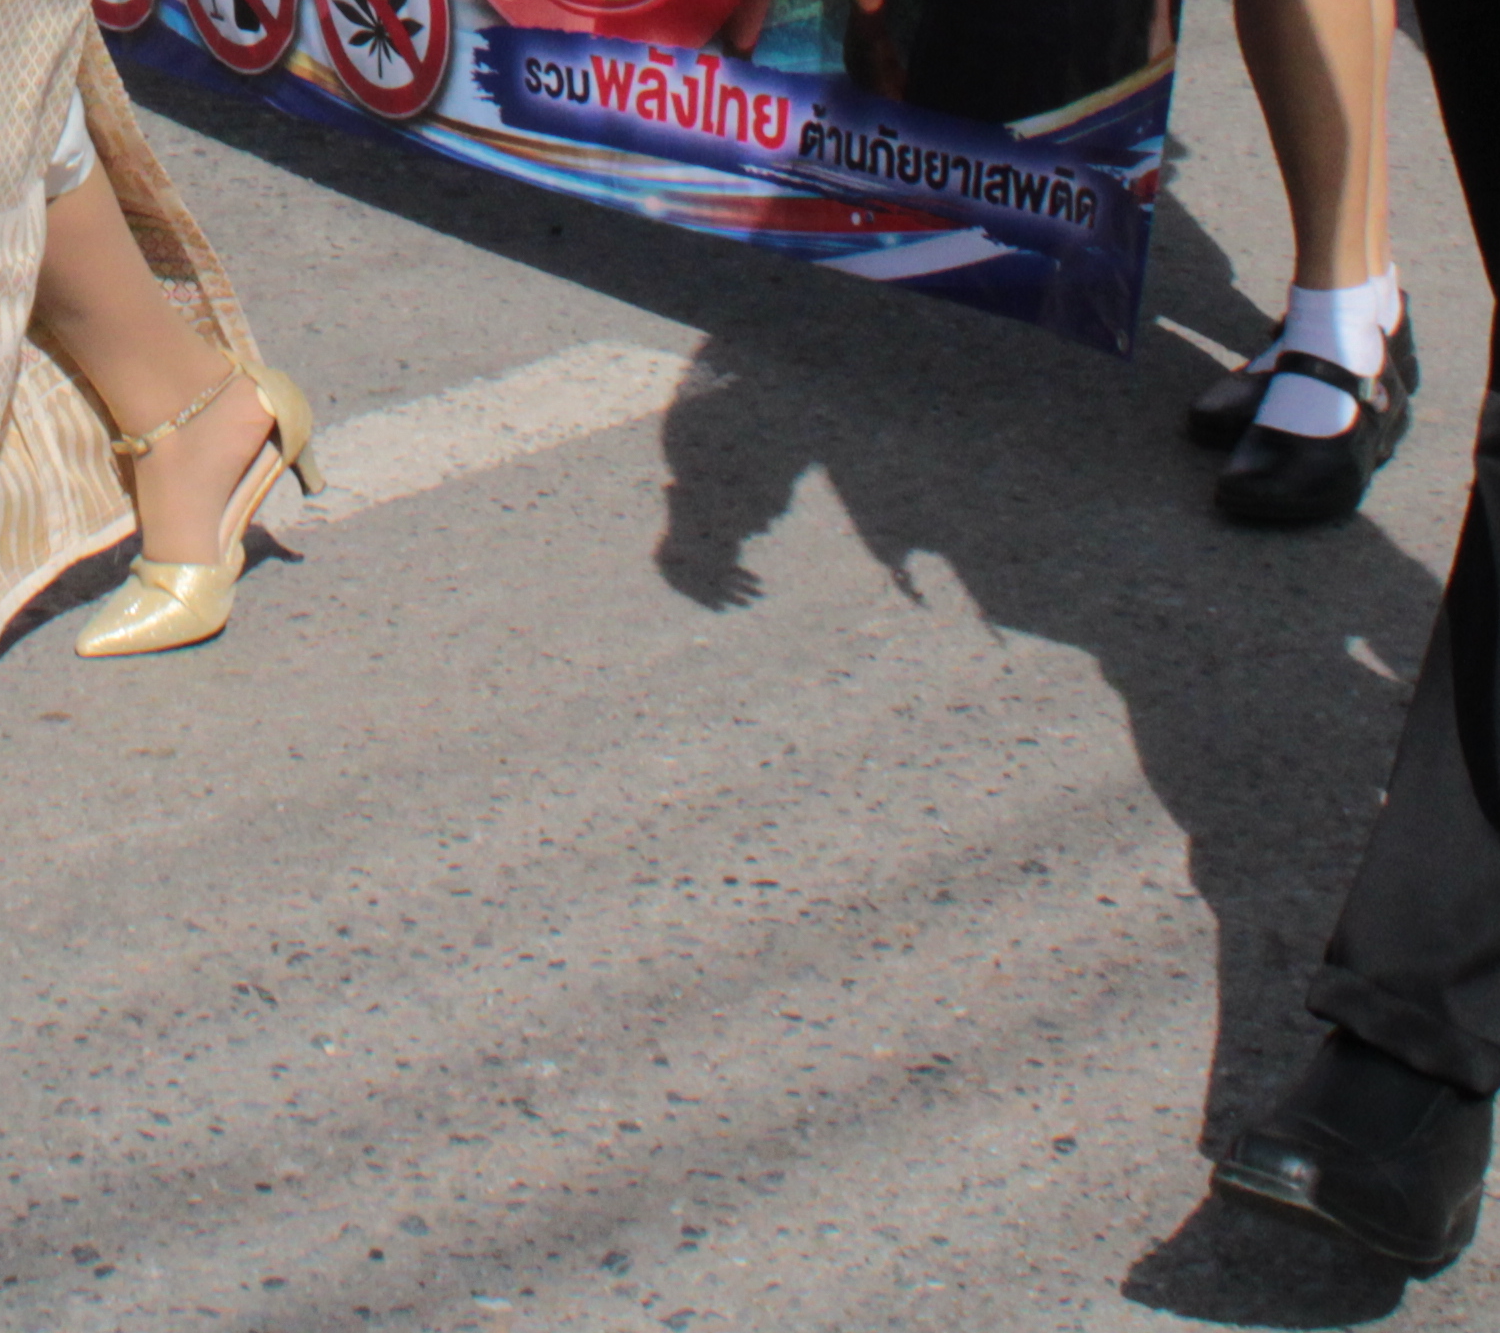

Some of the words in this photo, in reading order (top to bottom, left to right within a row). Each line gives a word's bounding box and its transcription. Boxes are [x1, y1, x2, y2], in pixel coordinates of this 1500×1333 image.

[523, 46, 791, 151] รวมพลังไทย
[799, 103, 1098, 230] ต้านภัยยาเสพติด
